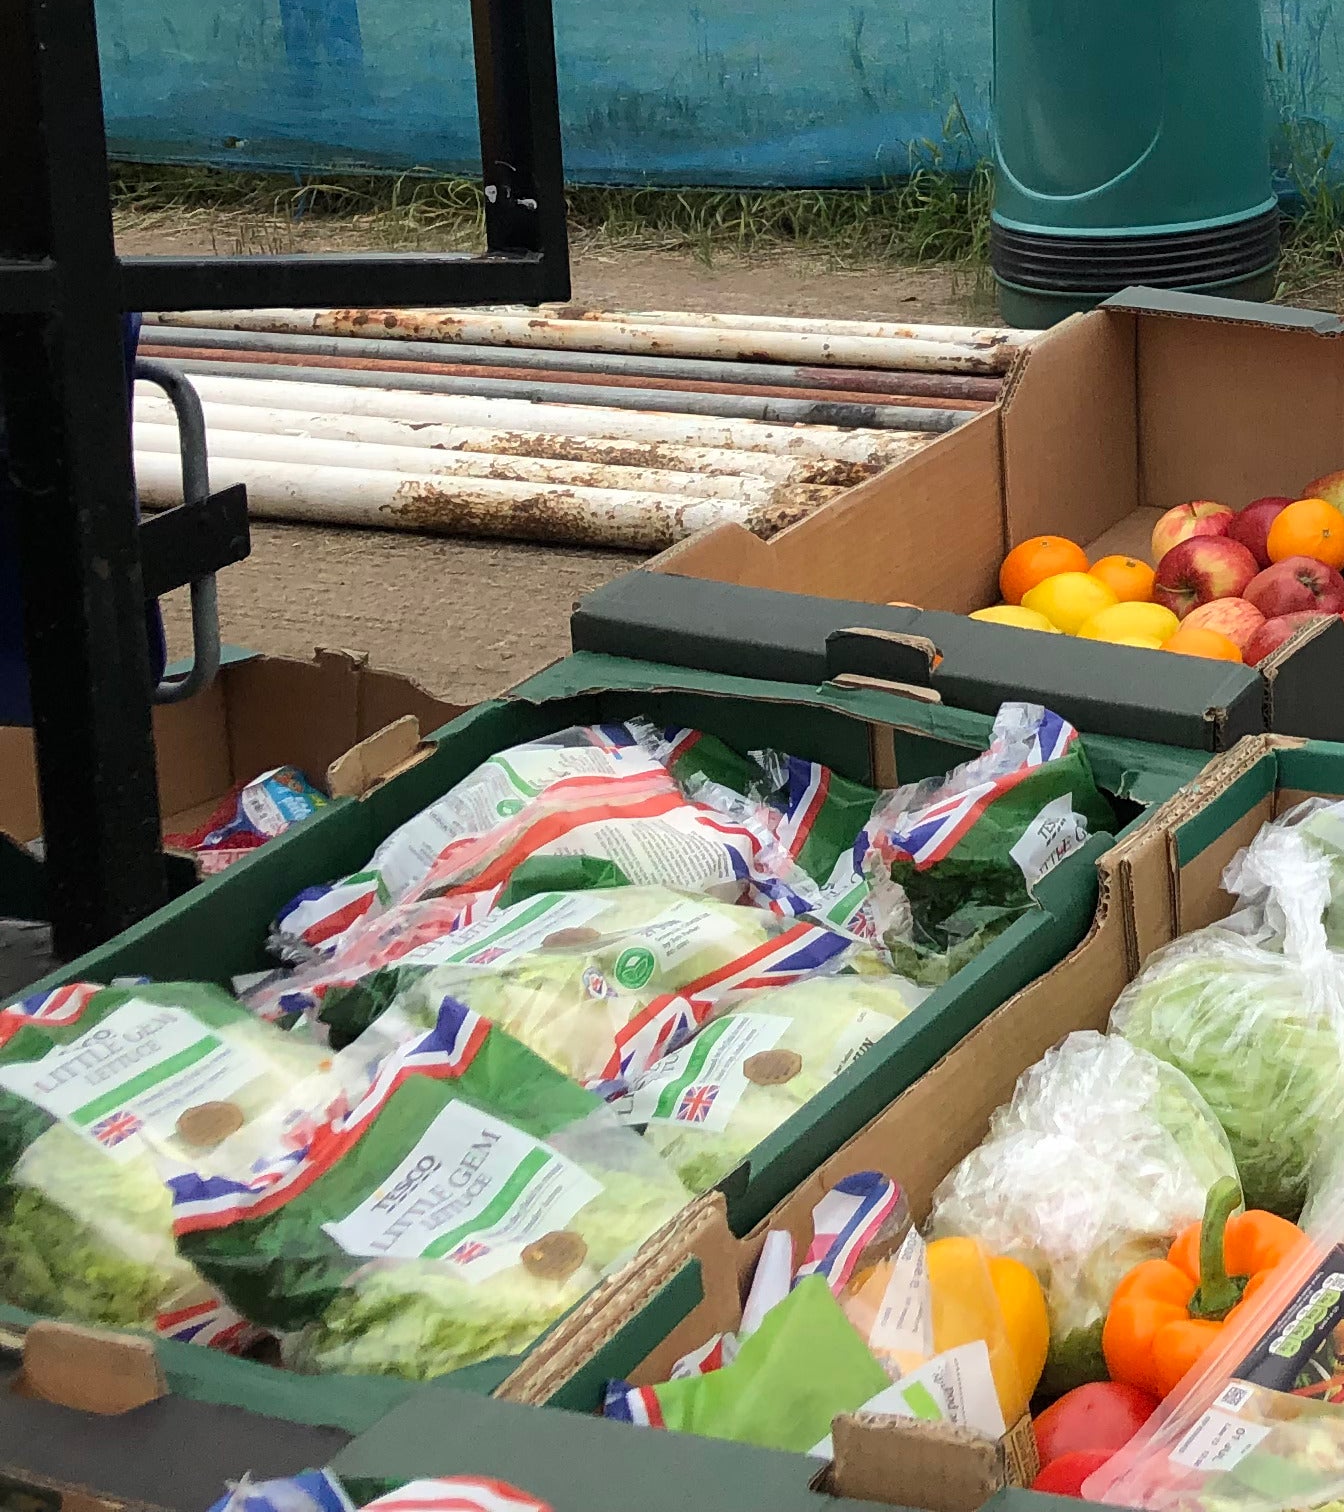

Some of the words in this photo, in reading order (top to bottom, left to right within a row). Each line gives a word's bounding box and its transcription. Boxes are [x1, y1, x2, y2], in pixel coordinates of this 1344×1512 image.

[33, 1041, 124, 1094] LITTLE
[84, 1039, 162, 1086] LETTUCE
[369, 1184, 451, 1251] LITTLE
[448, 1128, 503, 1189] GEM
[370, 1154, 436, 1211] TESCO
[420, 1174, 493, 1231] LETTUCE
